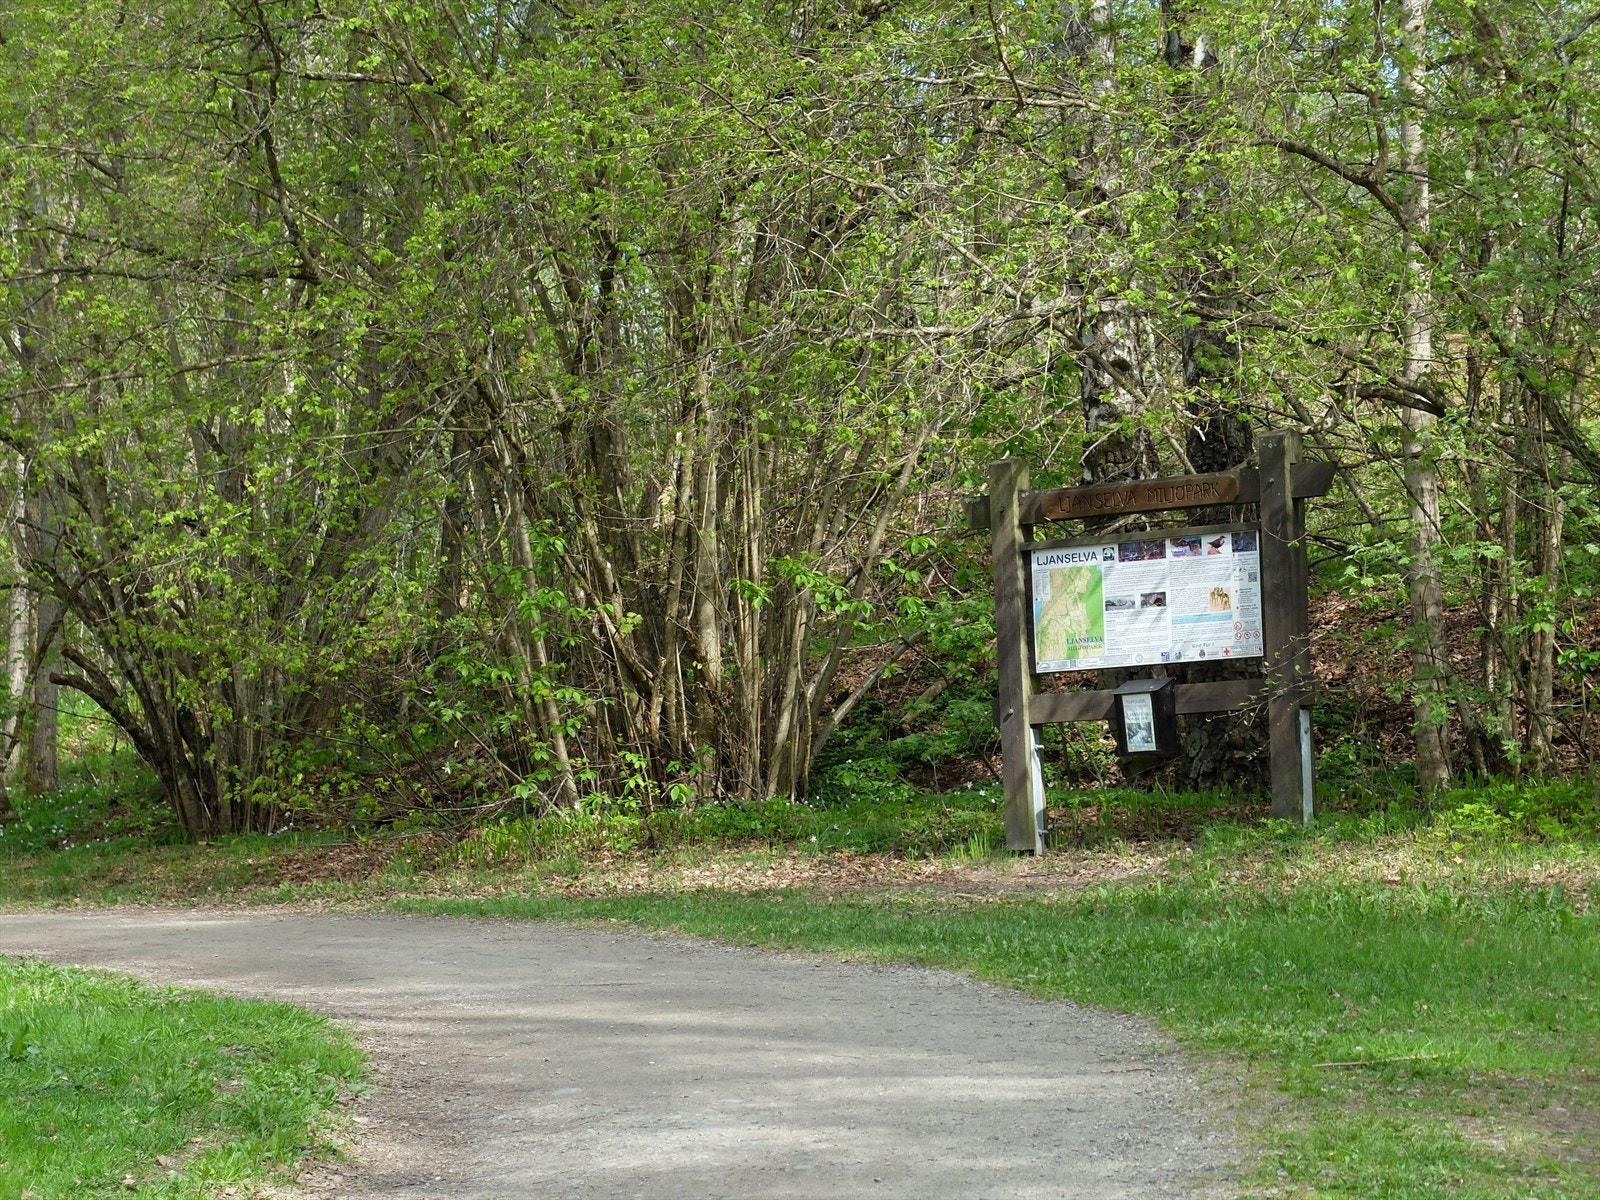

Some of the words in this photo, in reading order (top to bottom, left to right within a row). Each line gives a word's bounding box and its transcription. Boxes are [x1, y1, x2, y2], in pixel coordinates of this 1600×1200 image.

[1058, 490, 1136, 514] LJANSELVA
[1145, 481, 1220, 505] MILJØPARK
[1036, 551, 1098, 566] LJANSELVA
[1066, 636, 1103, 645] LJANSELVA
